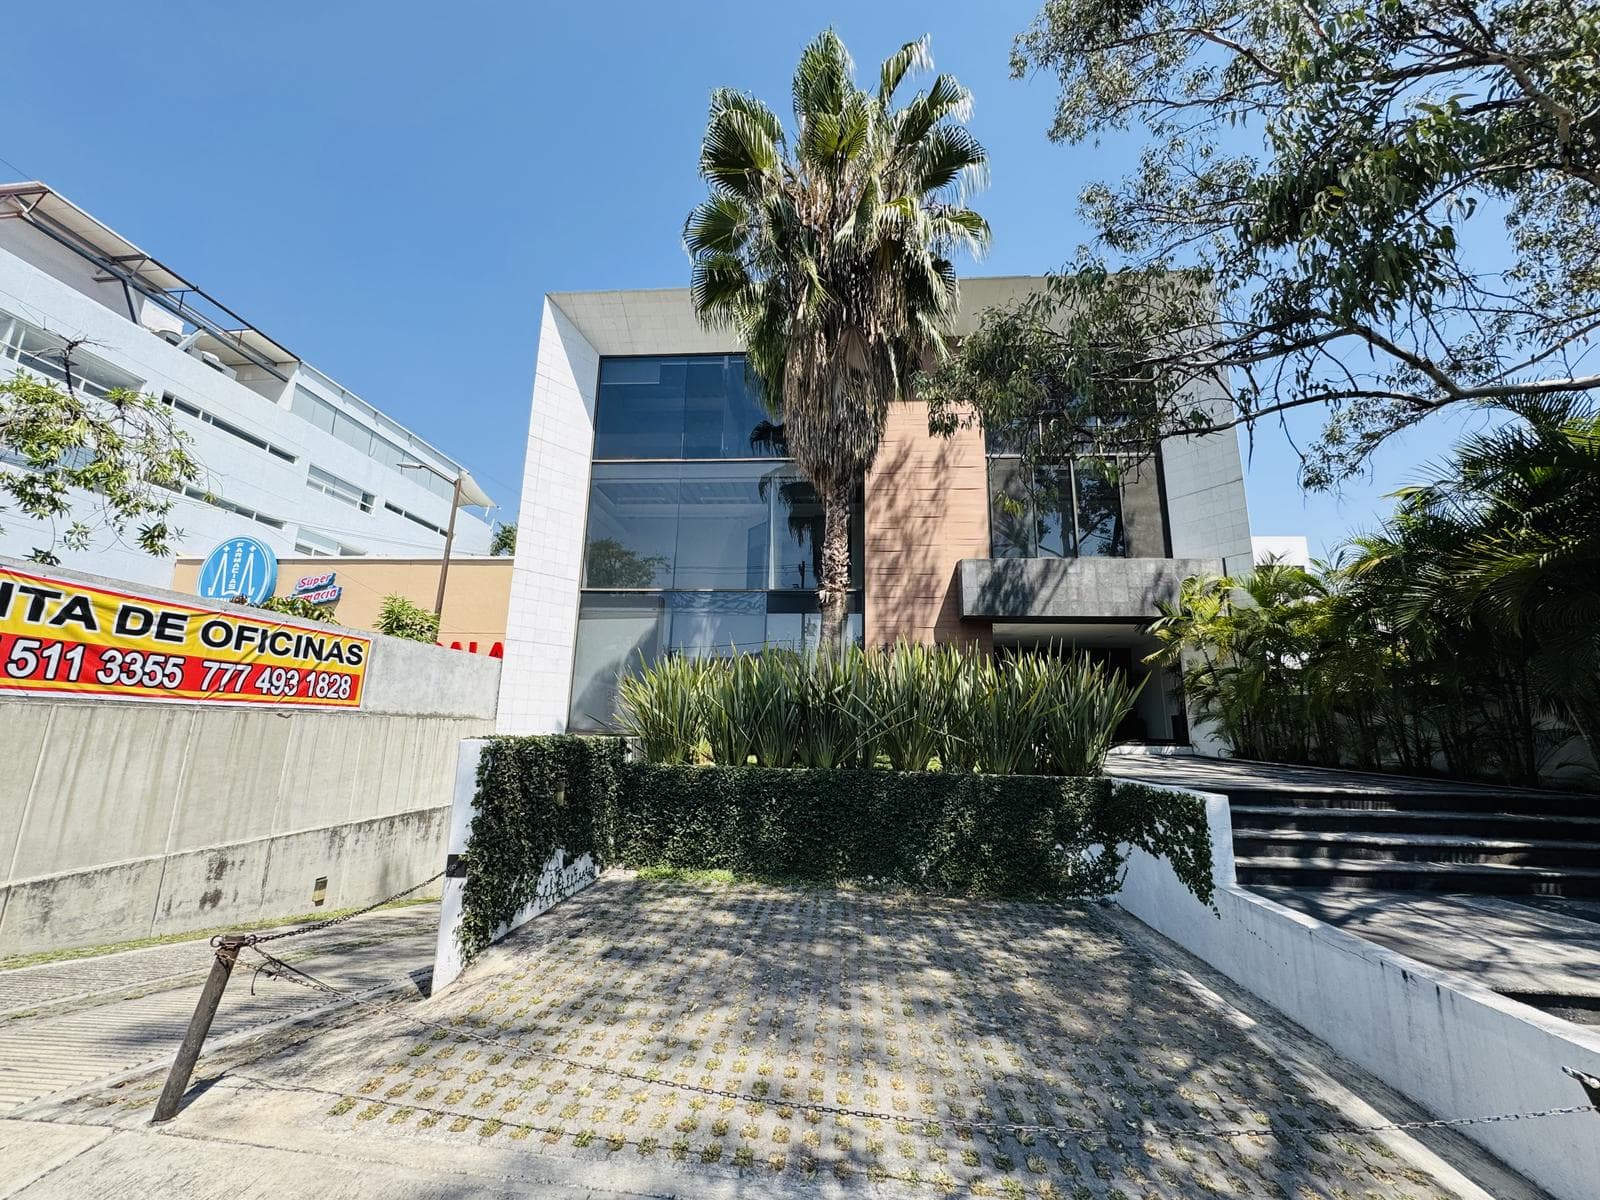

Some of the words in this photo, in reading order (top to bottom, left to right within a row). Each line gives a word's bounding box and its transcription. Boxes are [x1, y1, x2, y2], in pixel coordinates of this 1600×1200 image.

[227, 542, 244, 590] FARMACIAS
[298, 574, 331, 588] Super
[115, 604, 189, 643] DE
[200, 620, 363, 665] OFICINAS
[5, 637, 86, 681] 511
[95, 648, 187, 689] 3355
[201, 660, 252, 693] 777
[254, 665, 299, 697] 493
[305, 669, 352, 700] 1828
